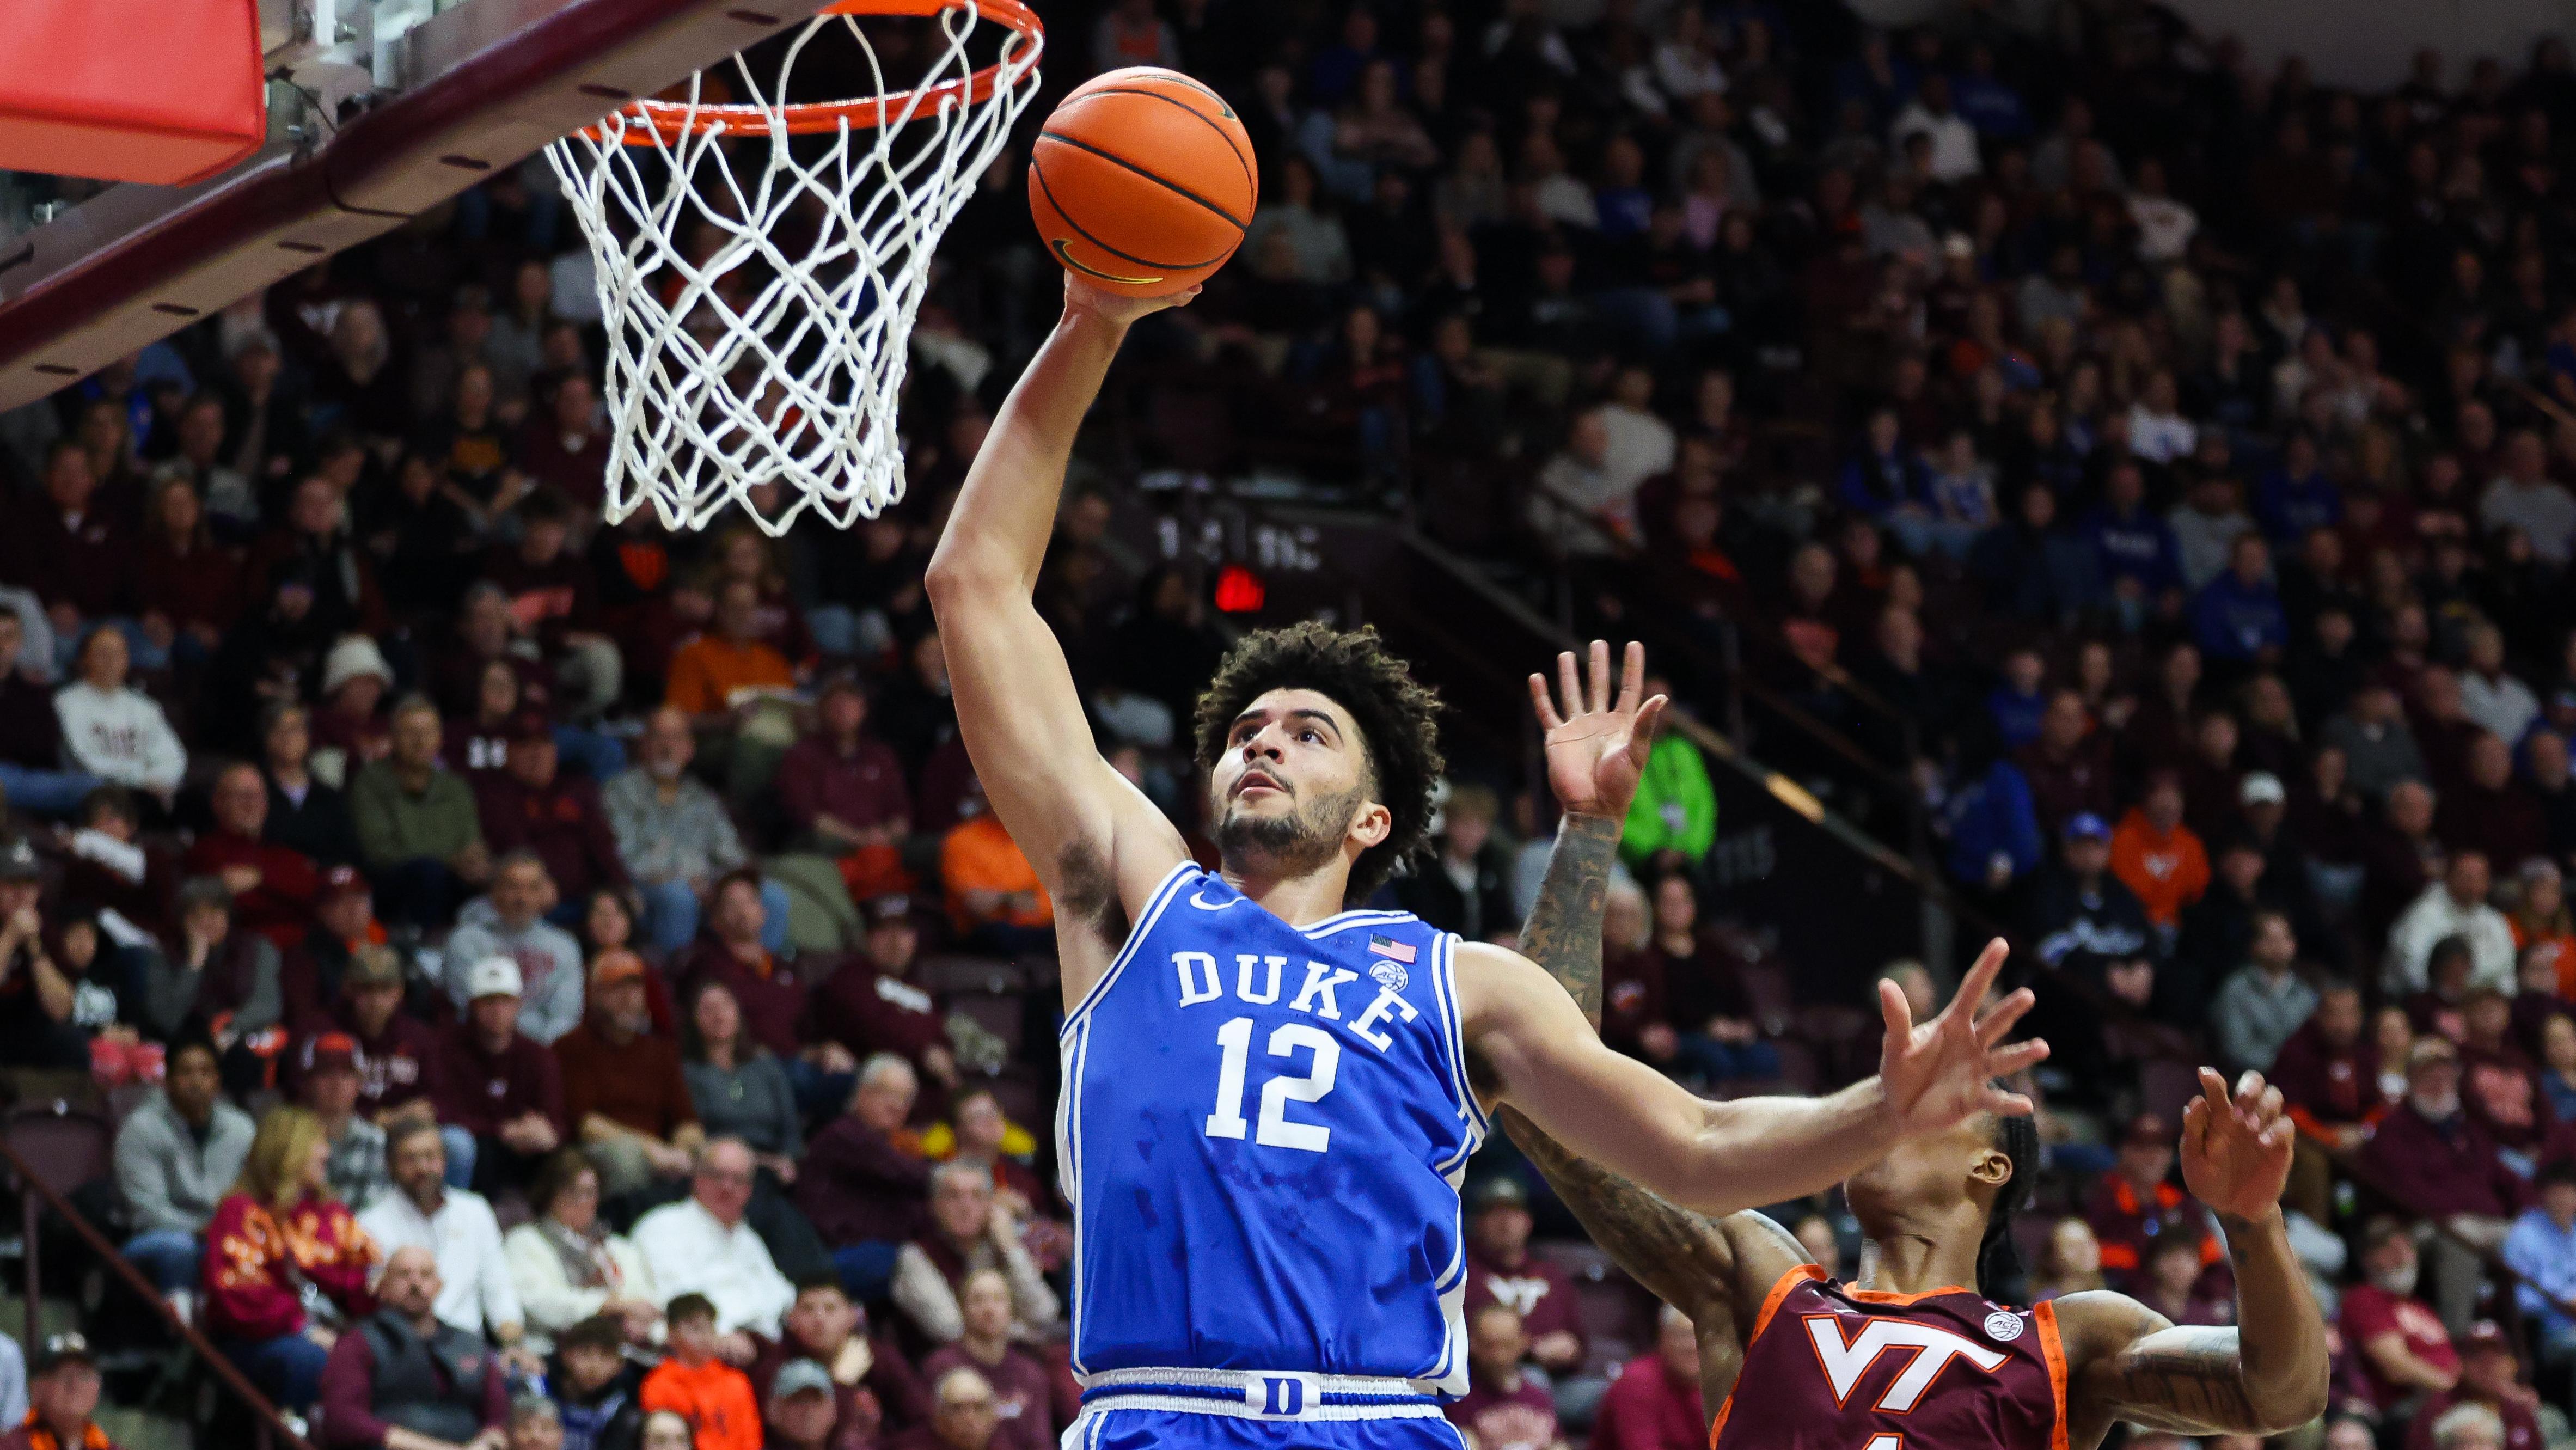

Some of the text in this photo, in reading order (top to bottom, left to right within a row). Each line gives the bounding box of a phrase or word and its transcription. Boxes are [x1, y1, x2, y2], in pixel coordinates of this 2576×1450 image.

[1171, 951, 1419, 1054] DUKE
[1205, 1017, 1341, 1153] 12
[1484, 1272, 1552, 1316] VT
[1262, 1377, 1303, 1415] D
[1801, 1314, 2014, 1416] VT
